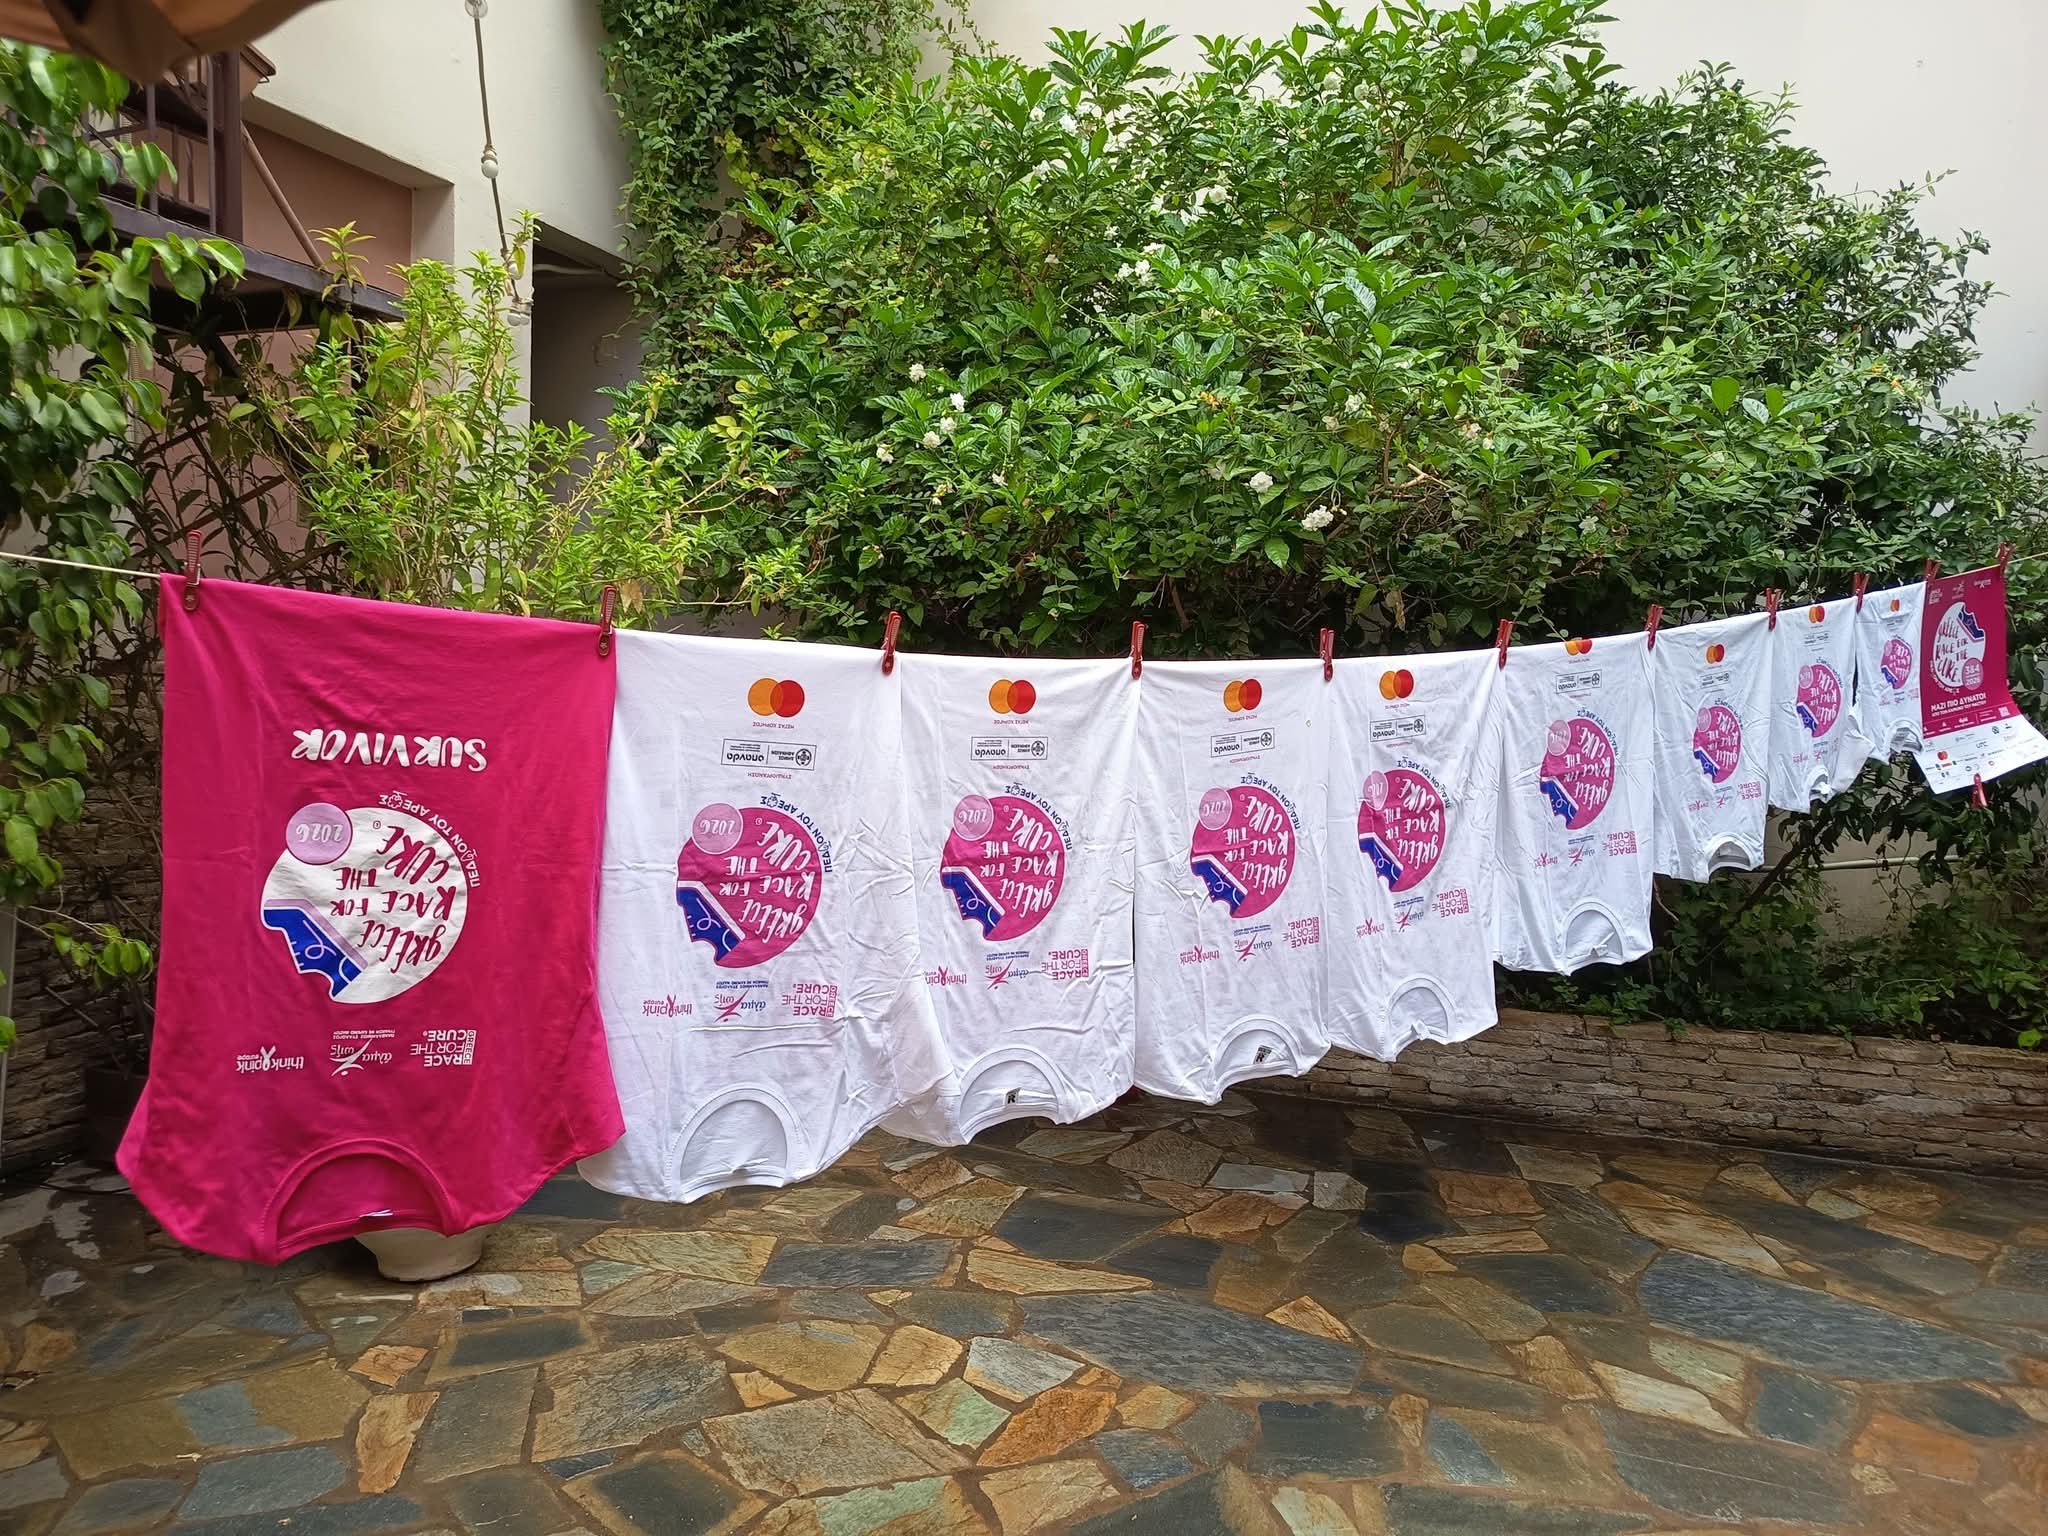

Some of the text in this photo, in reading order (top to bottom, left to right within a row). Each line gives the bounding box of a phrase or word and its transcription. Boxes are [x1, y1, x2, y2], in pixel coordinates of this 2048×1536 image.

[291, 729, 487, 773] SURVIVOR
[1036, 797, 1051, 813] ΤΟΥ
[1397, 778, 1436, 814] CURE
[797, 812, 814, 830] ΤΟΥ
[958, 808, 987, 824] 2026
[1242, 796, 1282, 834] CURE
[1403, 809, 1440, 834] RACE
[295, 822, 344, 843] 2026
[428, 813, 454, 836] ΤΟΥ
[700, 819, 736, 836] 2026
[1005, 808, 1053, 852] CURE
[1223, 826, 1249, 845] THE
[376, 825, 451, 885] CURE
[756, 821, 812, 871] CURE
[980, 840, 1011, 858] THE
[1223, 830, 1288, 863] RACE FOR
[1608, 846, 1631, 857] RACE
[723, 855, 758, 876] THE
[980, 850, 1059, 878] RACE FOR
[333, 867, 381, 891] THE
[719, 871, 815, 901] RACE FOR
[329, 886, 457, 921] RACE FOR
[1440, 906, 1463, 918] RACE
[1446, 898, 1462, 908] FOR
[1281, 929, 1298, 941] THE
[1295, 927, 1314, 939] FOR
[1291, 936, 1314, 949] RACE
[1041, 960, 1080, 971] FOR THE
[1052, 970, 1081, 980] RACE
[782, 994, 828, 1006] FOR THE
[793, 1005, 827, 1016] RACE
[410, 1041, 465, 1056] FOR THE
[424, 1053, 463, 1067] RACE
